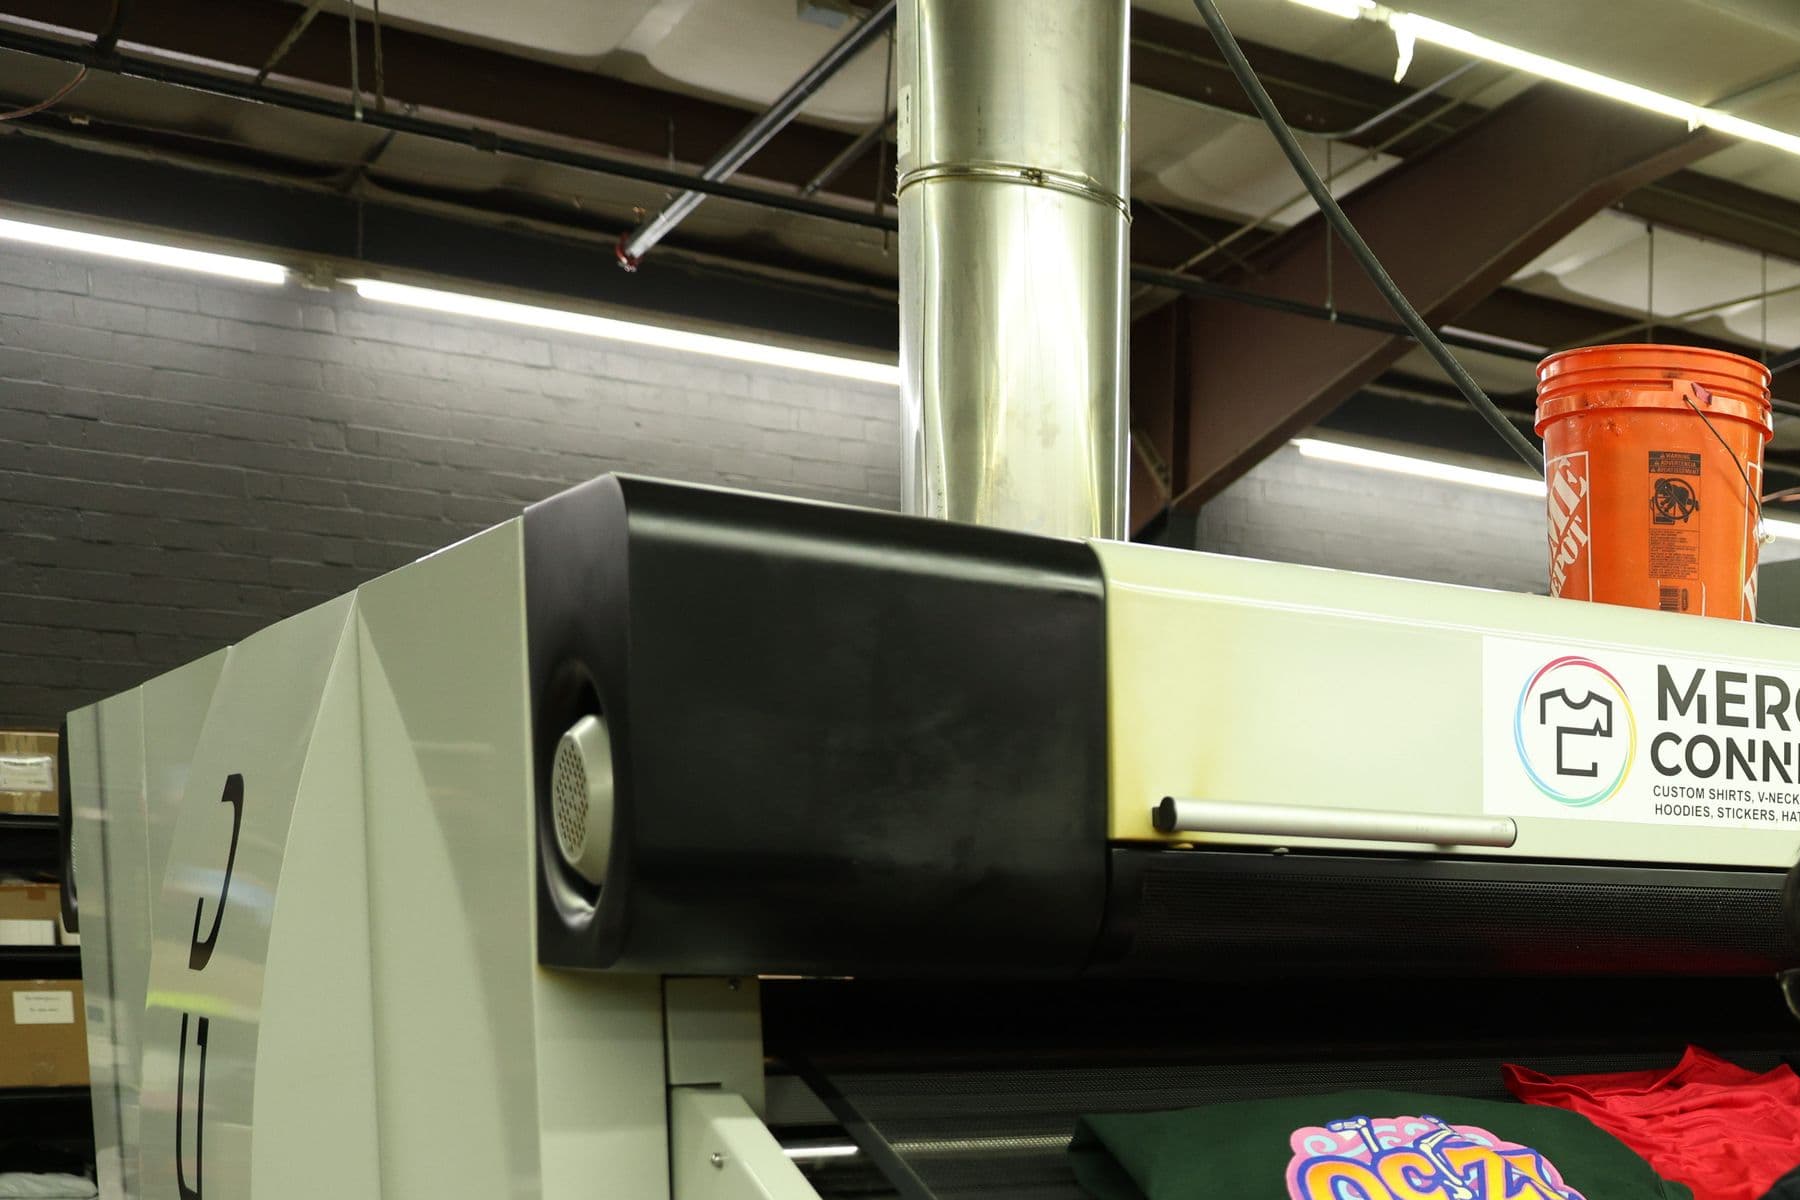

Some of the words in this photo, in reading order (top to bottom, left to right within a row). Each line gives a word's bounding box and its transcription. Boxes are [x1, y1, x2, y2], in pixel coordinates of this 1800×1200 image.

[1653, 785, 1705, 799] CUSTOM
[1709, 789, 1754, 803] SHIRTS,
[1655, 803, 1713, 819] HOODIES,
[1717, 808, 1779, 823] STICKERS,
